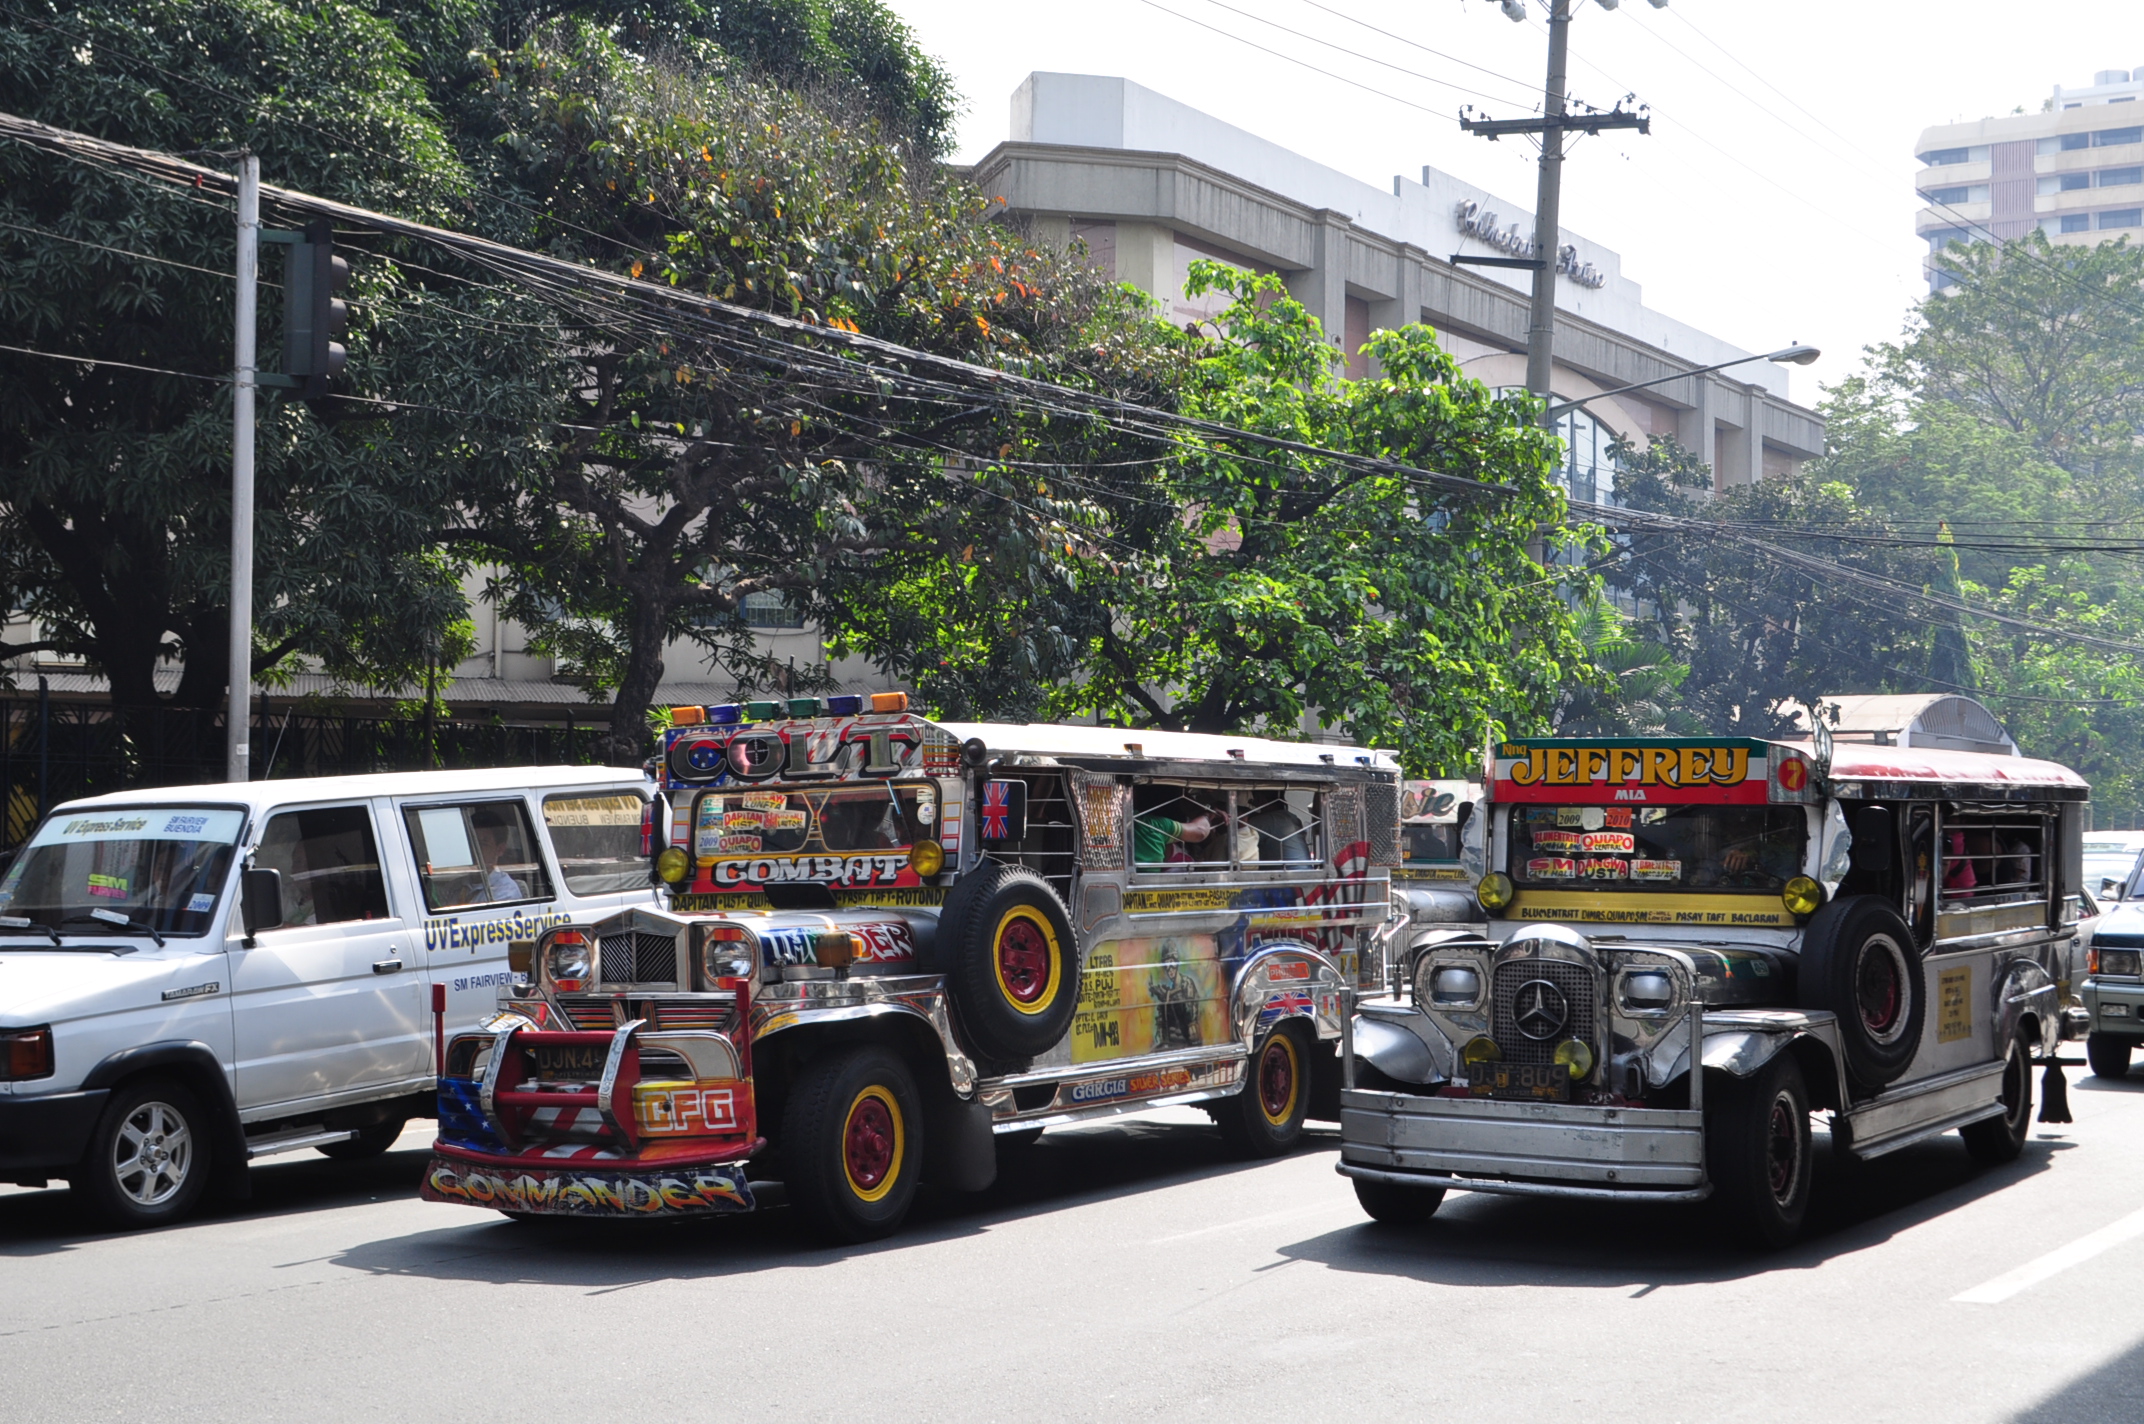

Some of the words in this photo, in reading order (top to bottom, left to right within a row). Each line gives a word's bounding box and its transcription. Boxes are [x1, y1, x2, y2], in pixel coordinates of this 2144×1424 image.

[670, 722, 921, 783] COLT
[1502, 744, 1527, 757] King
[1510, 747, 1751, 787] JEFFREY
[1786, 761, 1801, 789] 7
[1614, 790, 1647, 801] MIA
[724, 812, 762, 827] DAPITAN
[1559, 814, 1580, 826] 2009
[1606, 814, 1631, 826] 2010
[163, 824, 202, 834] BUENDIA
[698, 836, 719, 848] 2009
[719, 836, 761, 853] QUIAPO
[1582, 834, 1634, 851] QUIAPO
[1594, 843, 1624, 851] CENTRAL
[715, 854, 909, 886] COMBAT
[1528, 858, 1574, 871] SM
[1577, 857, 1628, 877] DANGWA
[1528, 870, 1547, 878] CITY
[1551, 870, 1575, 878] HALL
[1585, 868, 1617, 878] UST
[88, 873, 128, 891] SM
[188, 900, 211, 910] 2009
[672, 894, 718, 912] DAPITAN
[723, 894, 742, 909] UST
[870, 890, 893, 903] TAFT
[1521, 907, 1580, 919] BLUMENTRITT
[1676, 911, 1704, 922] PASAY
[1706, 912, 1726, 922] TAFT
[1731, 913, 1780, 923] BACLARAN
[1089, 955, 1114, 969] LTFRB
[204, 983, 219, 993] FX
[454, 979, 469, 991] SM
[470, 973, 513, 989] FAIRVIEW
[1095, 978, 1114, 991] PUJ
[1129, 1076, 1160, 1093] SILVER
[1160, 1070, 1192, 1088] SERIES
[1072, 1079, 1127, 1102] GARCIA
[641, 1089, 738, 1132] CFG
[430, 1167, 747, 1213] COMMANDER
